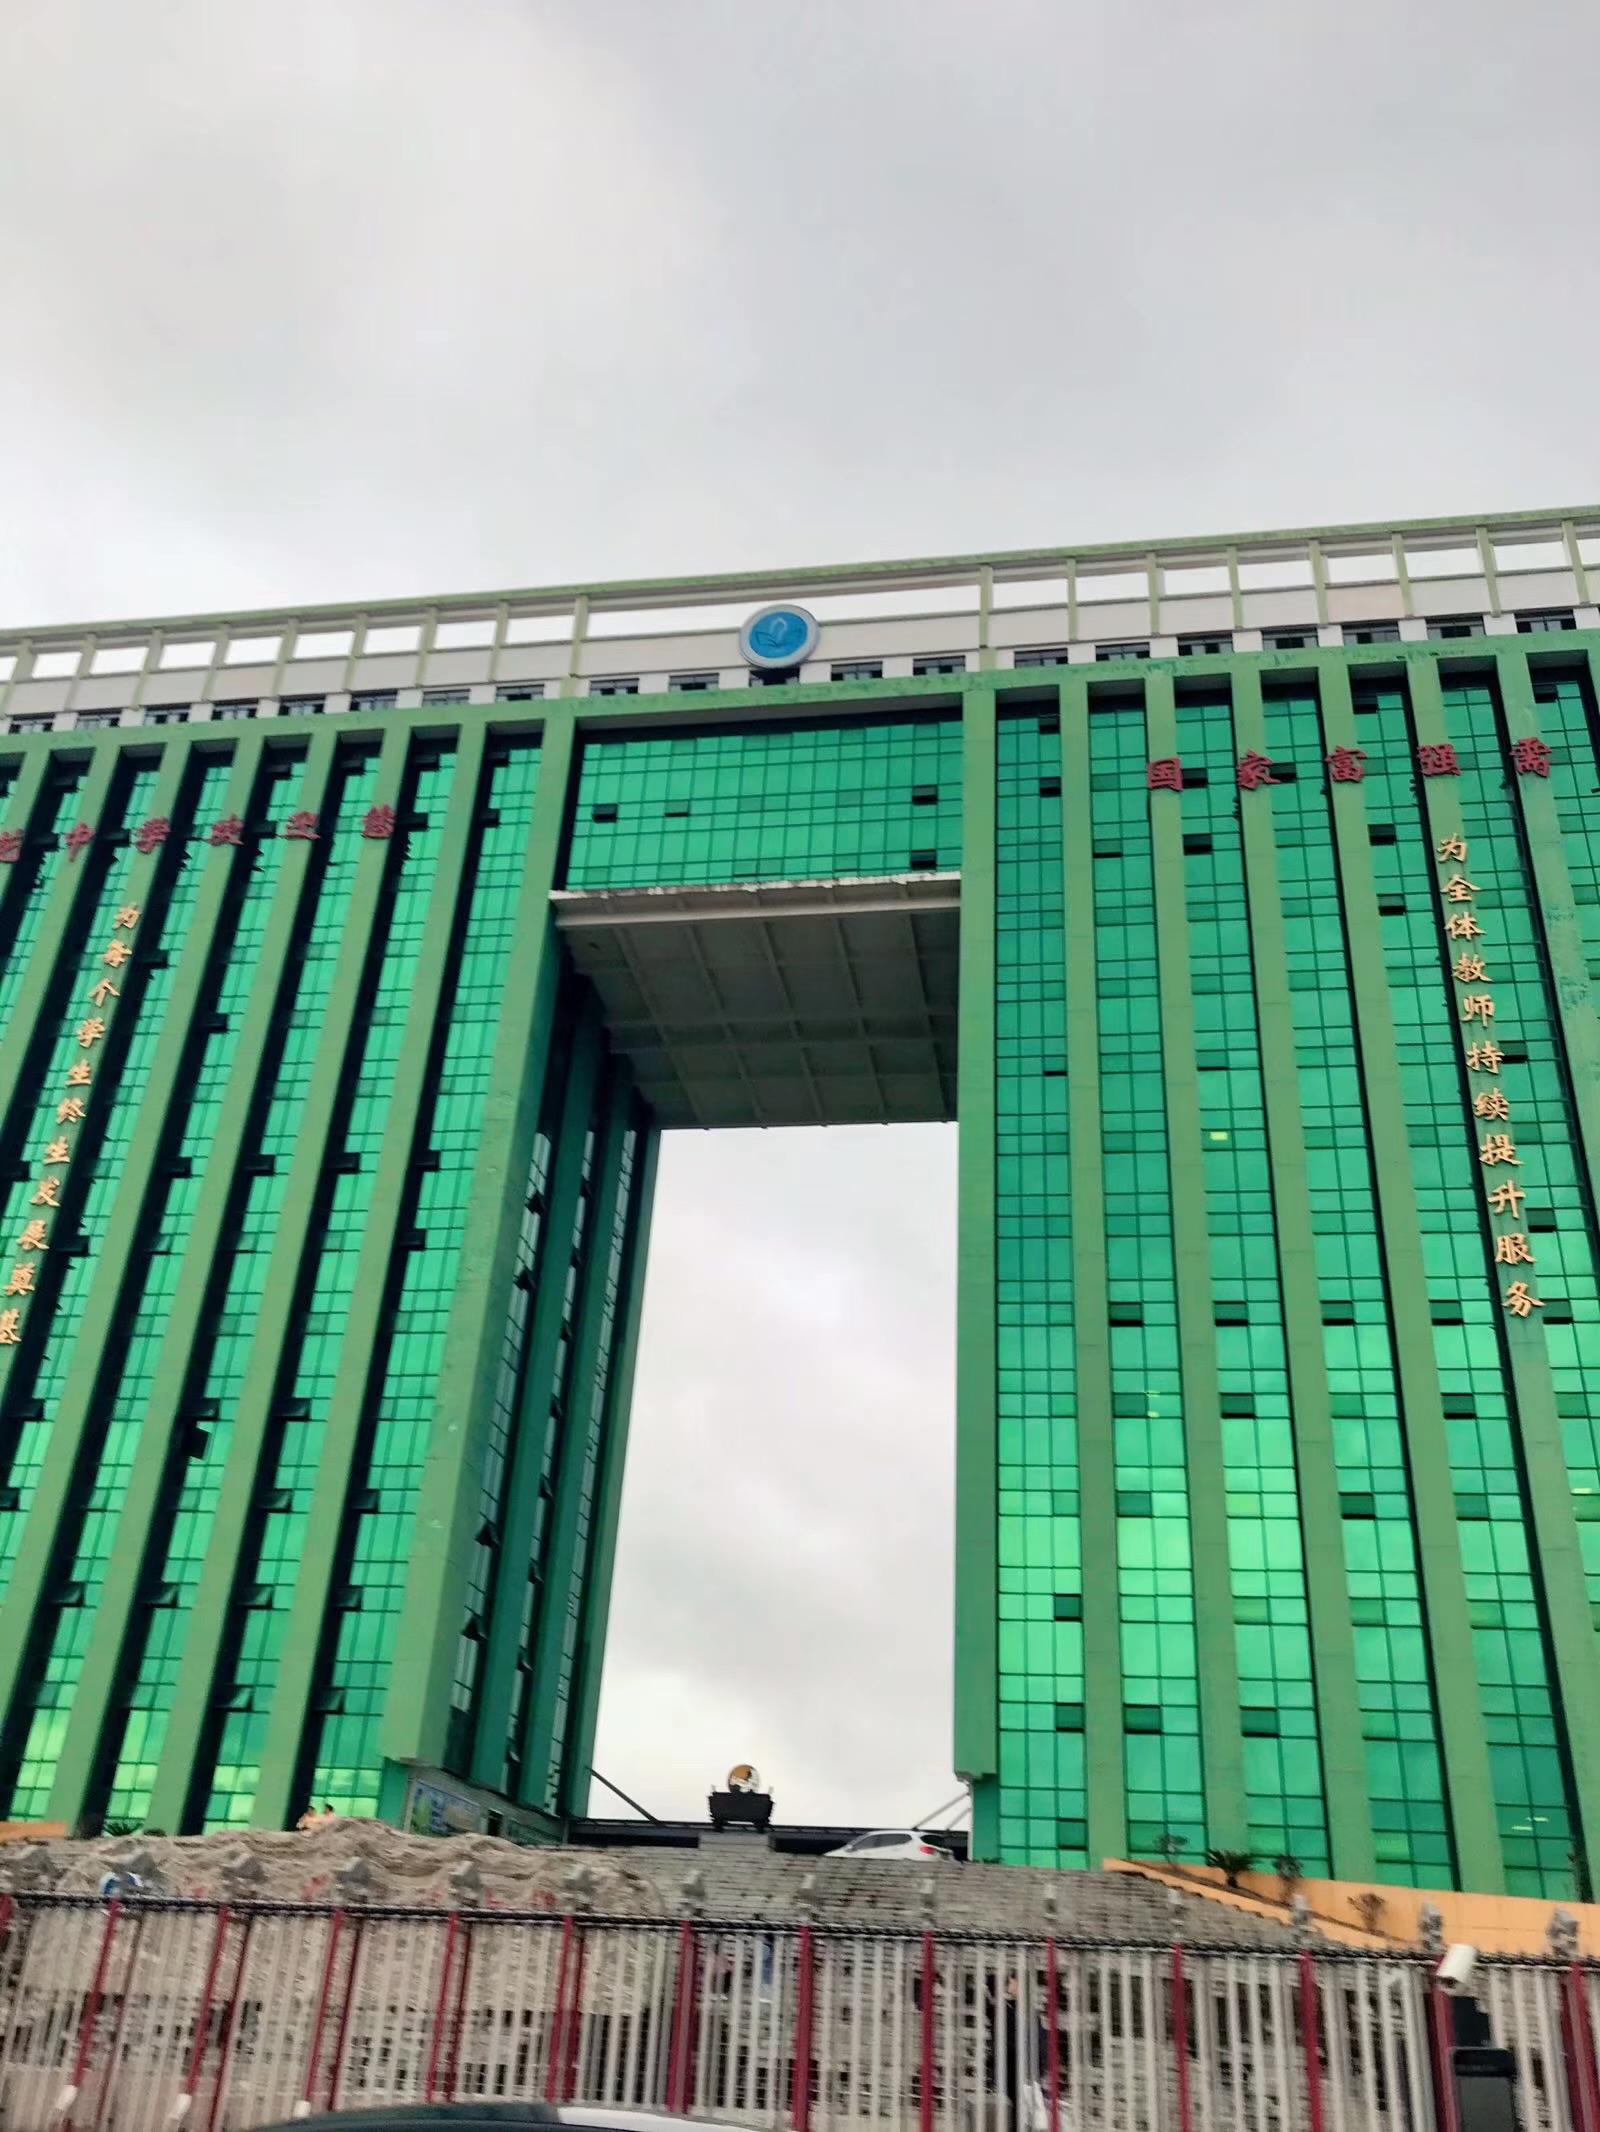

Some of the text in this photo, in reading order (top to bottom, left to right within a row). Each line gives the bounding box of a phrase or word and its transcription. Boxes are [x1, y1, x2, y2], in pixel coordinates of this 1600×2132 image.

[1436, 832, 1545, 1319] 为全体教师持续提升服务
